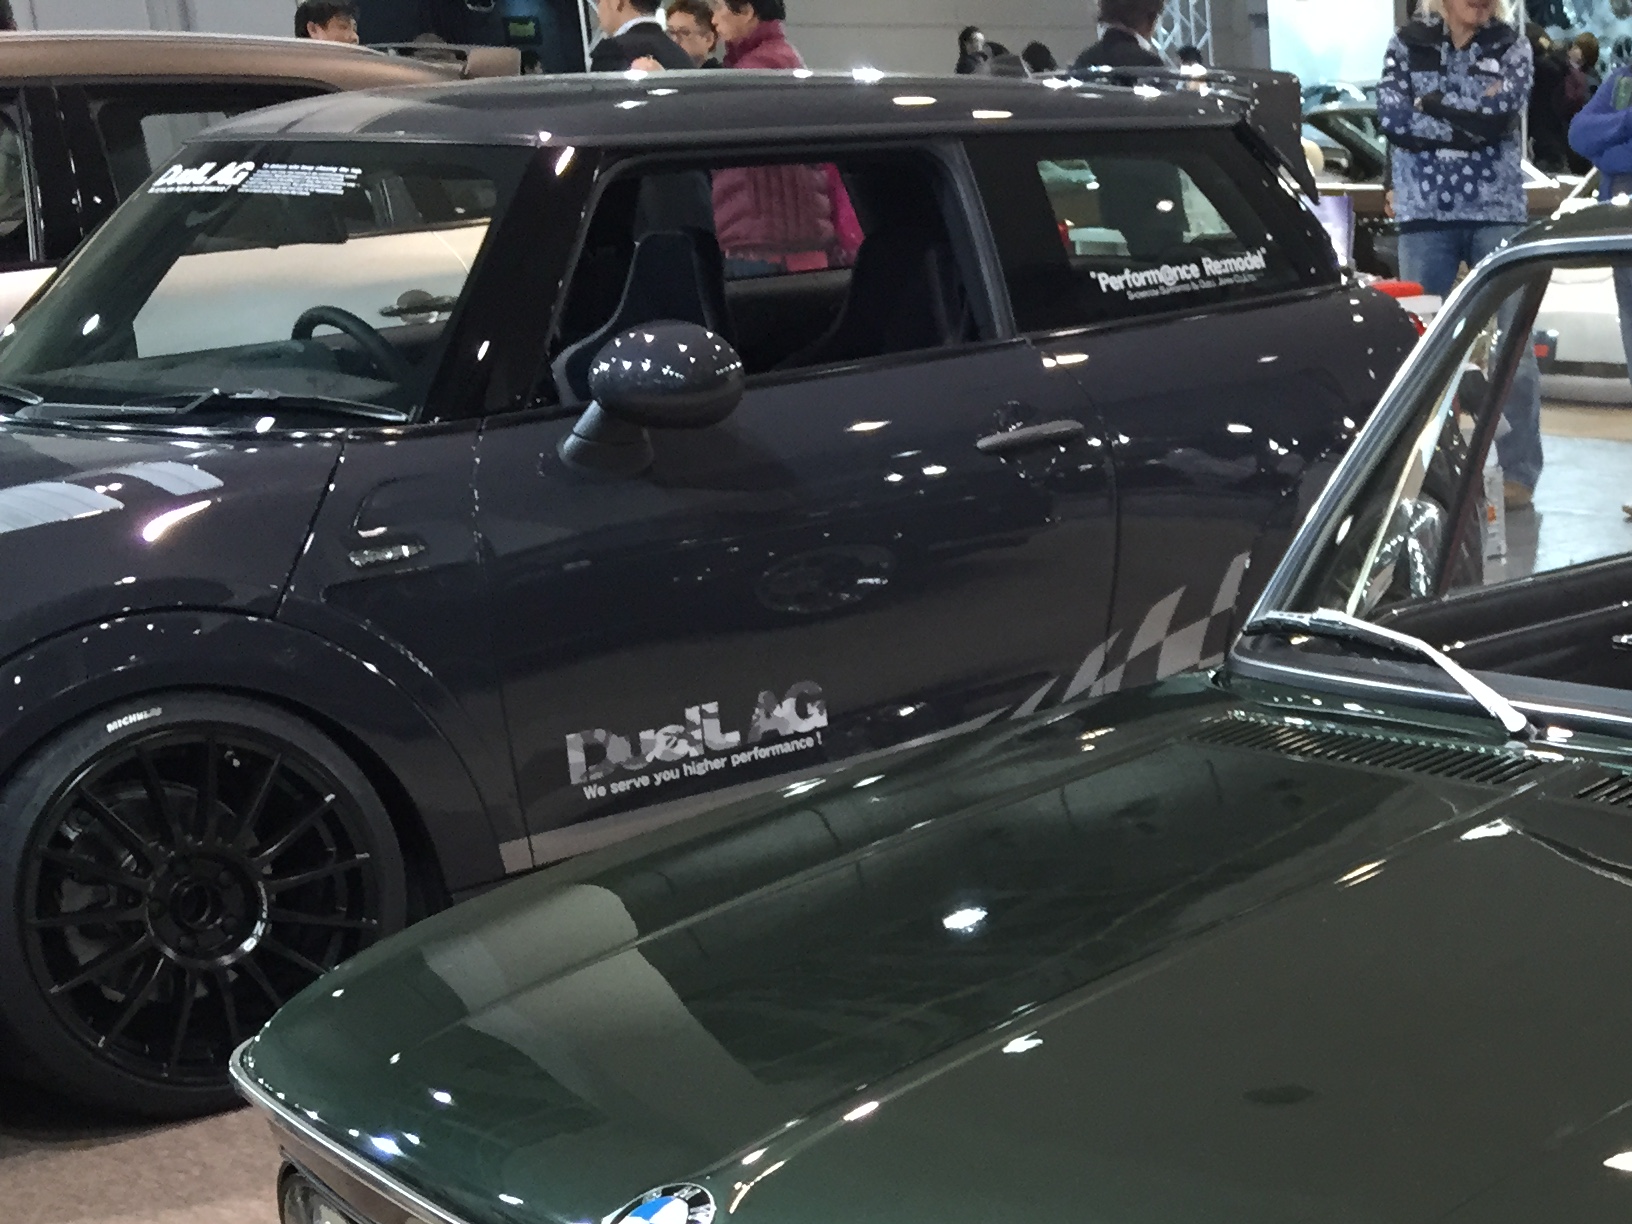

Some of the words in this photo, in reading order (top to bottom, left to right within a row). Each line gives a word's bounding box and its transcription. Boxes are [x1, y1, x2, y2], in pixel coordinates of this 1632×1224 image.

[583, 784, 607, 801] We
[610, 774, 651, 795] serve
[653, 766, 681, 786] you
[683, 755, 728, 777] higher
[731, 738, 815, 767] performance
